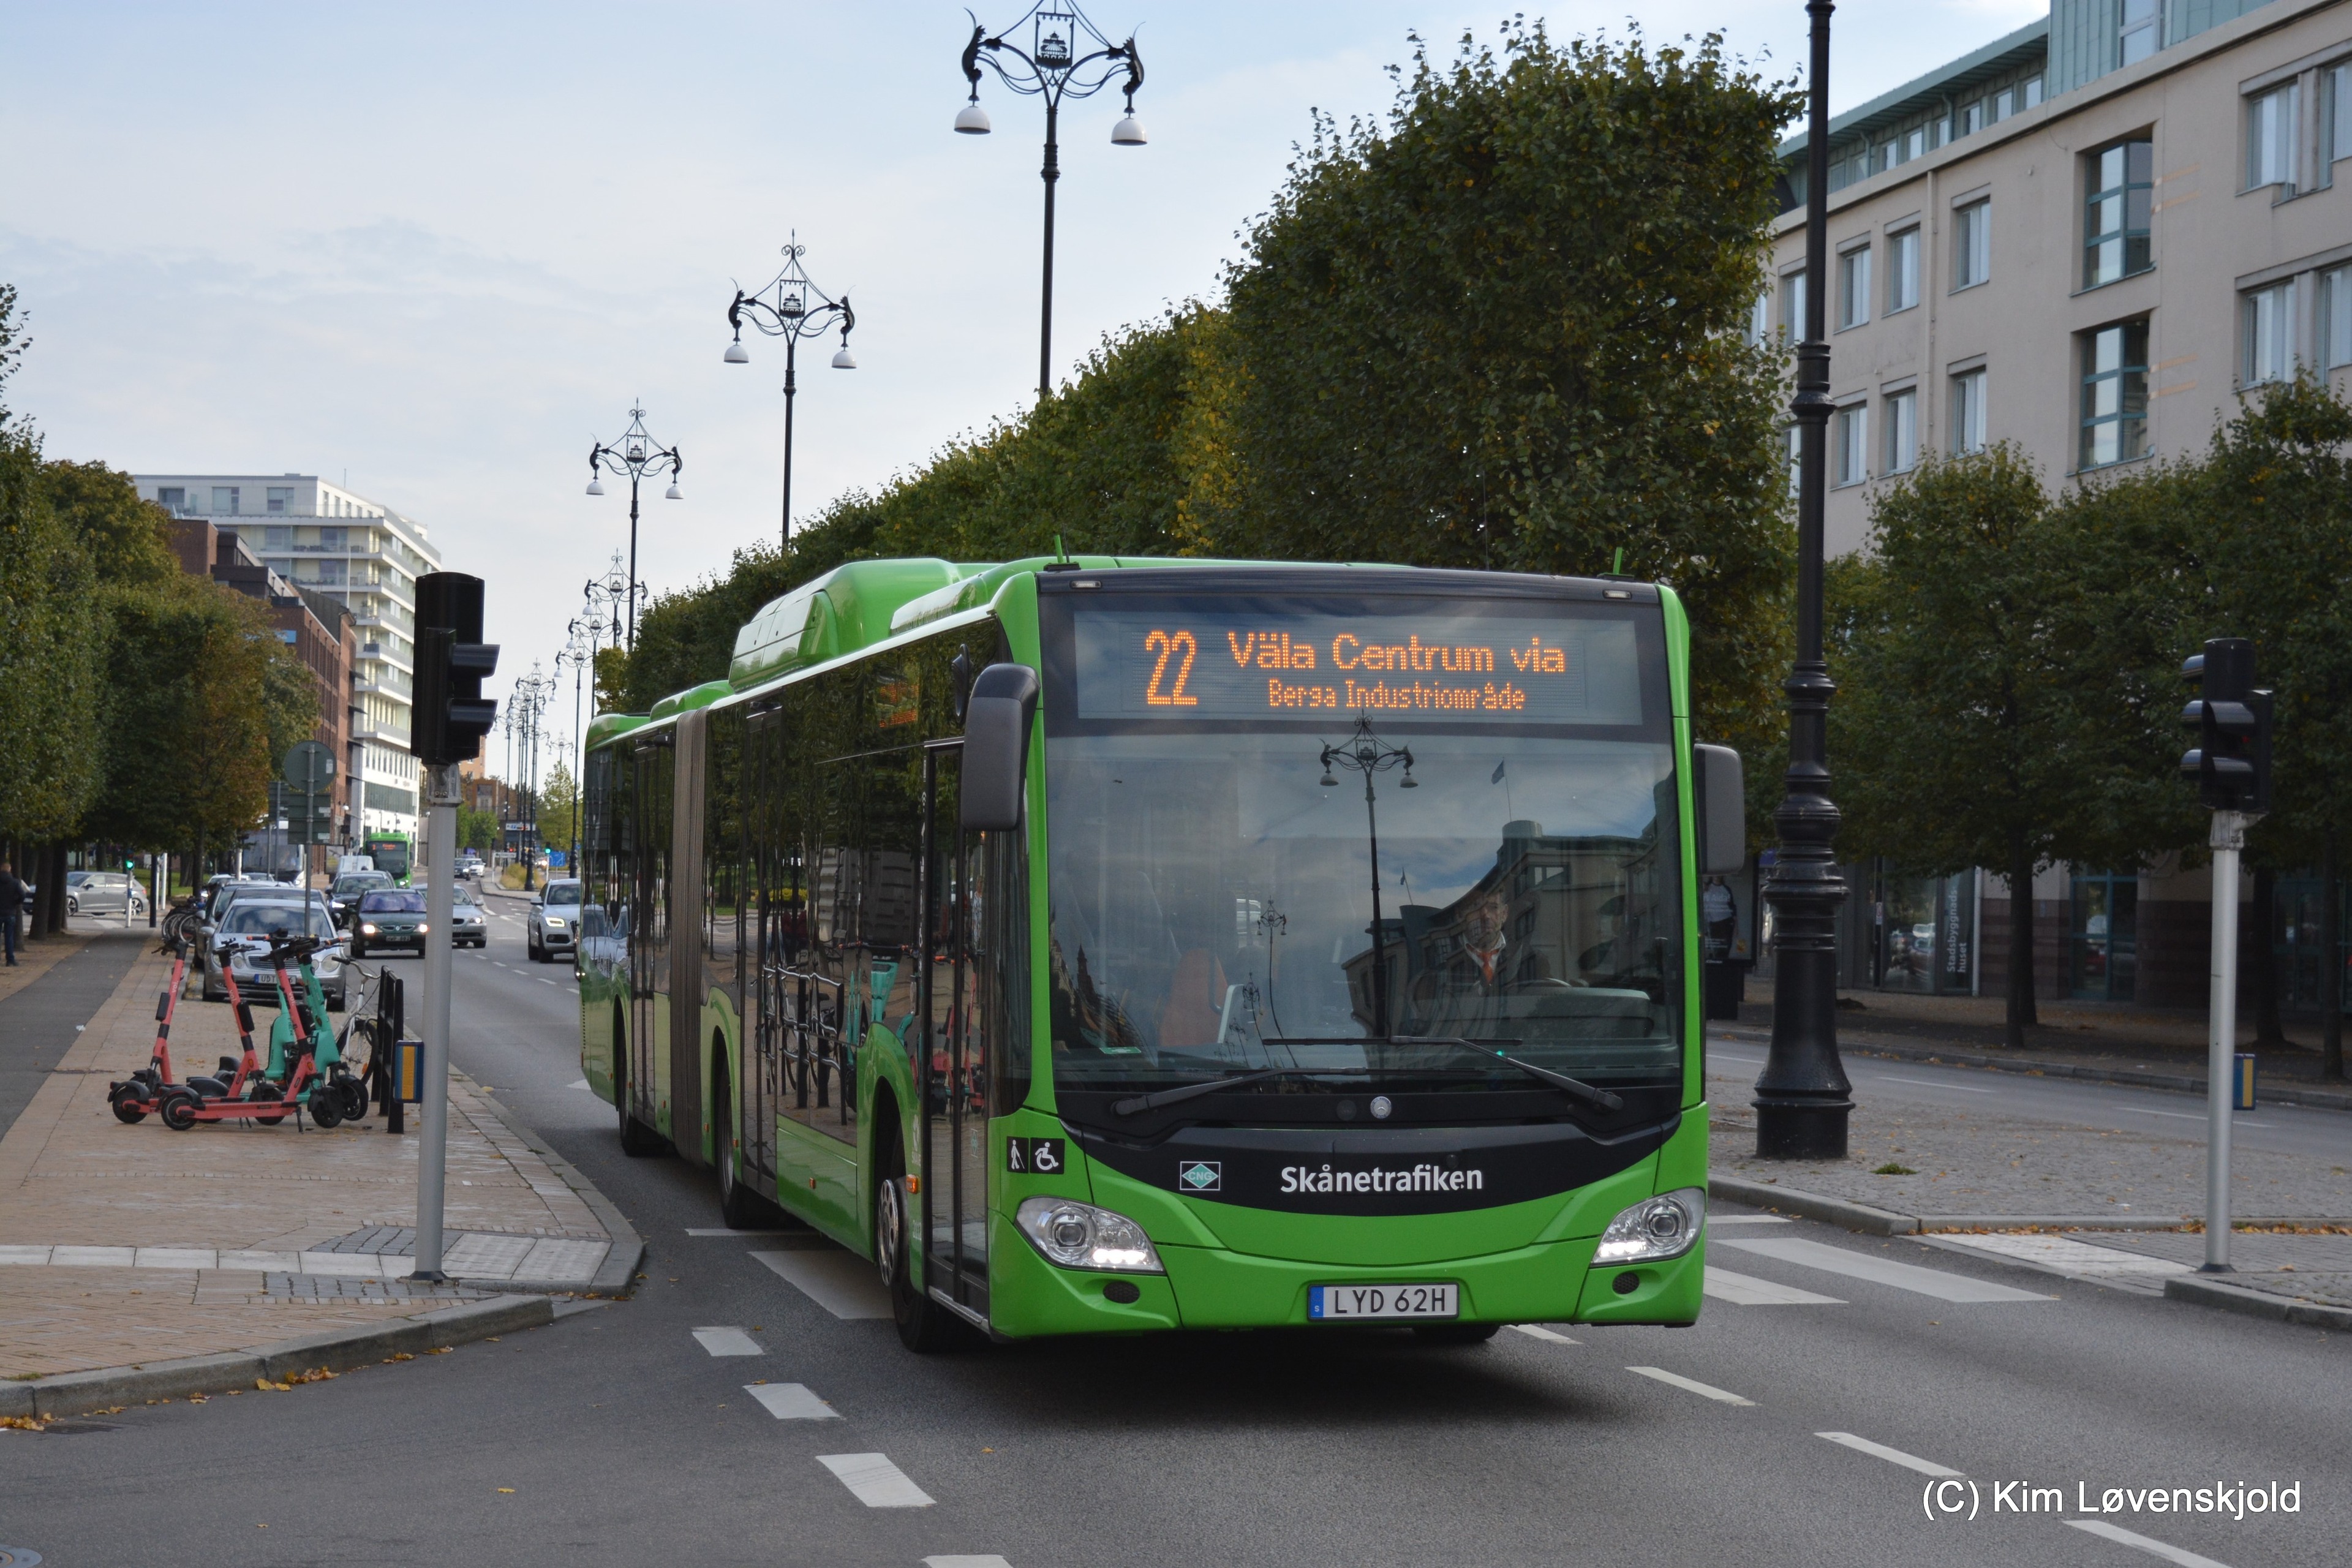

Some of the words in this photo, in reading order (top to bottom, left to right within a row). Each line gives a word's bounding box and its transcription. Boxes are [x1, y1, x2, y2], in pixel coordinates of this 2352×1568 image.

[1146, 631, 1197, 705] 22
[1228, 632, 1315, 669] Väla
[1333, 633, 1493, 671] Centrum
[1510, 637, 1565, 673] via
[1268, 677, 1336, 707] Berga
[1346, 680, 1526, 710] Industriområde
[1947, 889, 1959, 972] Stadsbyggnads
[1958, 943, 1967, 973] huset
[1188, 1171, 1213, 1181] CNG
[1280, 1164, 1483, 1193] Skånetrafiken
[1335, 1289, 1384, 1314] LYD
[1394, 1287, 1445, 1313] 62H
